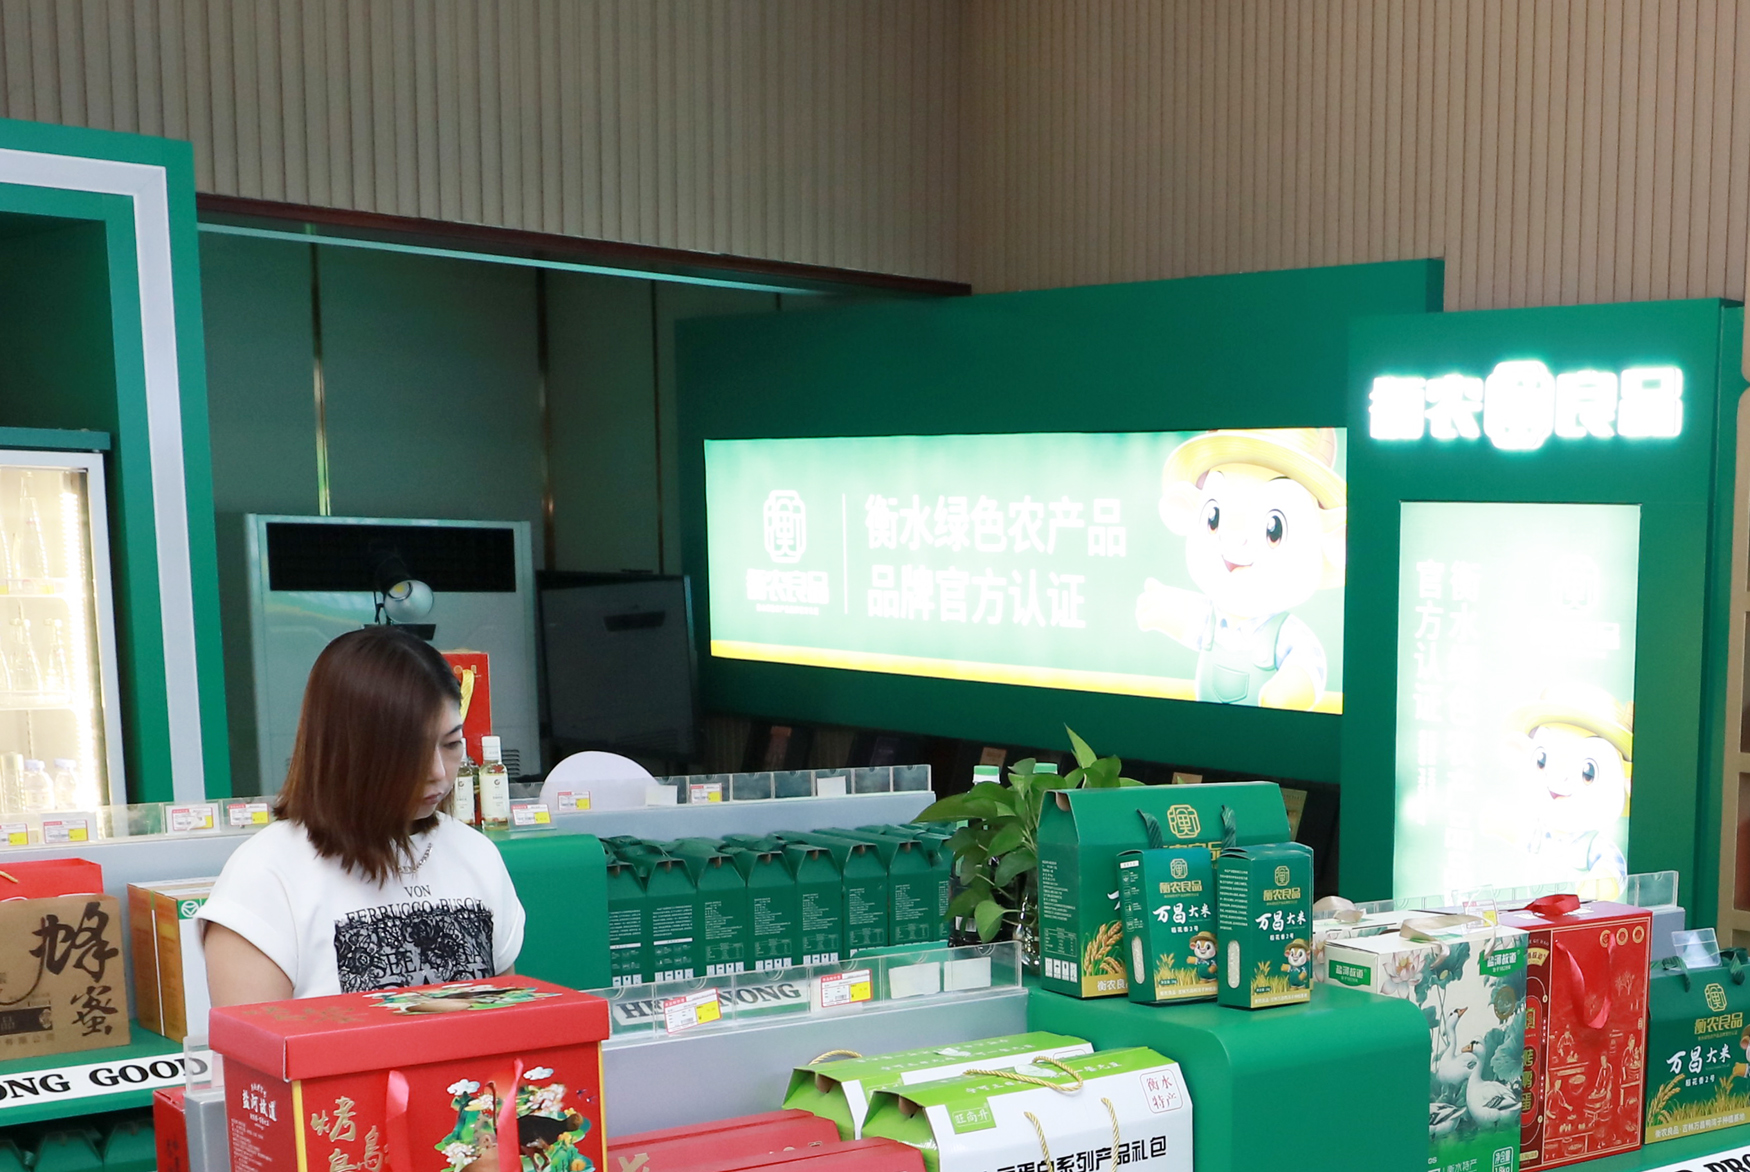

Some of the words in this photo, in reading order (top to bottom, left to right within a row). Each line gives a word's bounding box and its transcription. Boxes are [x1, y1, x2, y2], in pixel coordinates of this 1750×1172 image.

[864, 493, 1128, 558] 衡水绿色农产品
[867, 564, 1086, 629] 品牌官方认证
[404, 885, 431, 898] VON
[1153, 902, 1212, 924] 万昌大米
[1255, 910, 1307, 932] 万昌大米
[1097, 979, 1128, 992] 衡农良
[1666, 1043, 1732, 1075] 万昌大米
[0, 1073, 71, 1102] NG
[89, 1057, 208, 1087] GOOD
[1147, 1077, 1173, 1091] 衡水
[1152, 1093, 1177, 1109] 特产
